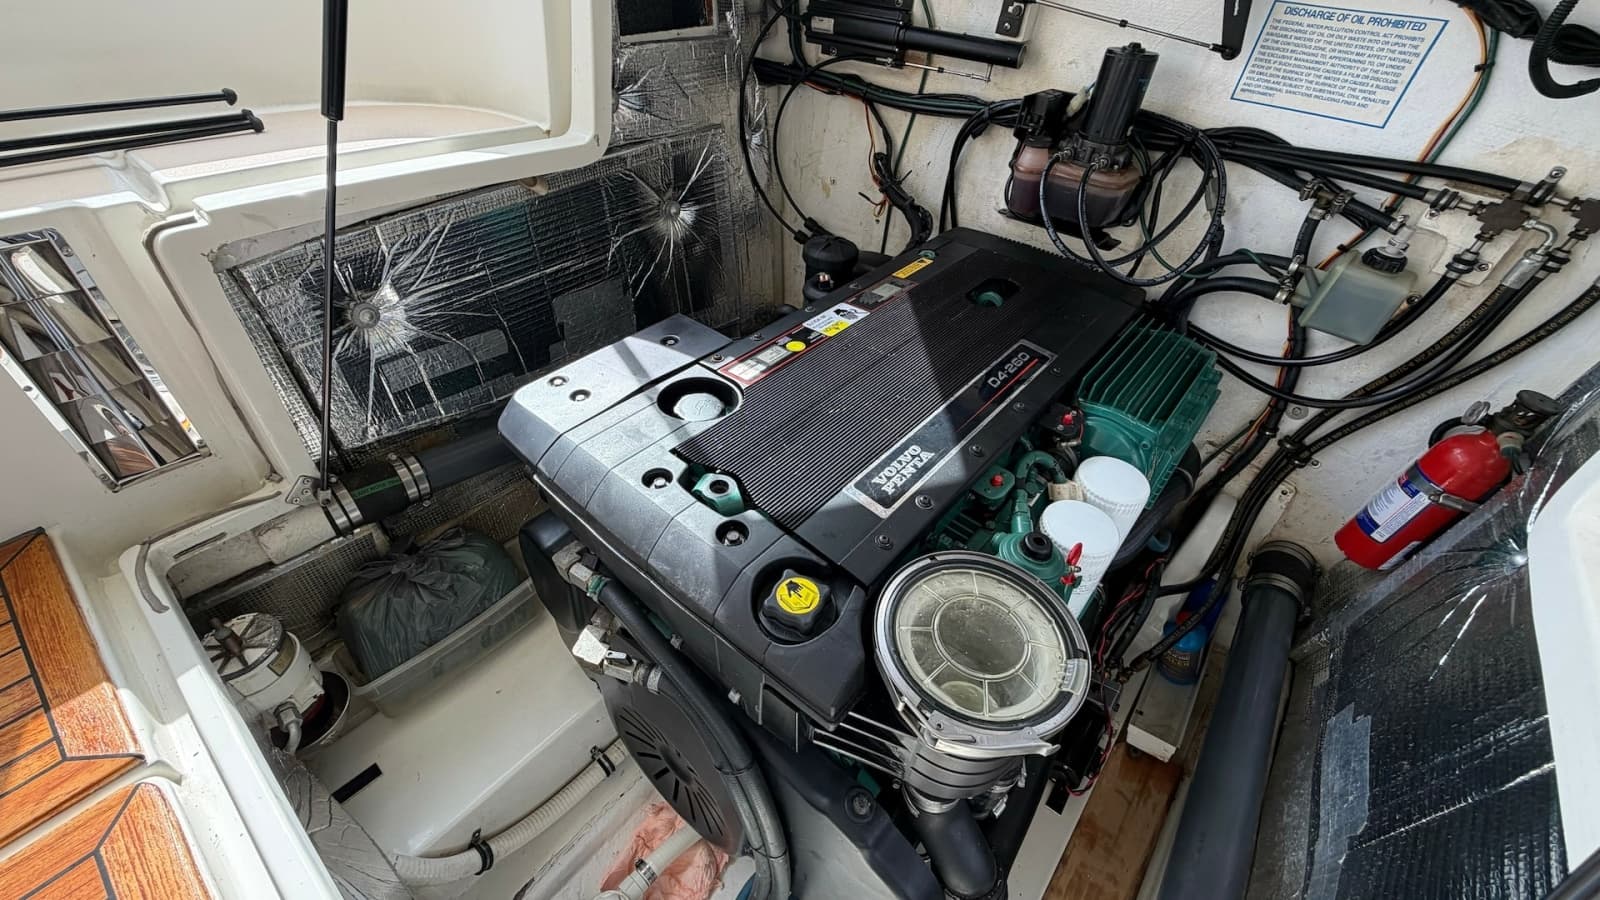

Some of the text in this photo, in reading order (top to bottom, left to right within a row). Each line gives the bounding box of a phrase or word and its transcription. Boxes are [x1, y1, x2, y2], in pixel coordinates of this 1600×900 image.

[1283, 6, 1428, 32] DISCHARGE OF OIL PROHIBITED
[987, 352, 1030, 388] D4-260
[871, 445, 922, 486] VOLVO
[880, 452, 935, 495] PENTA
